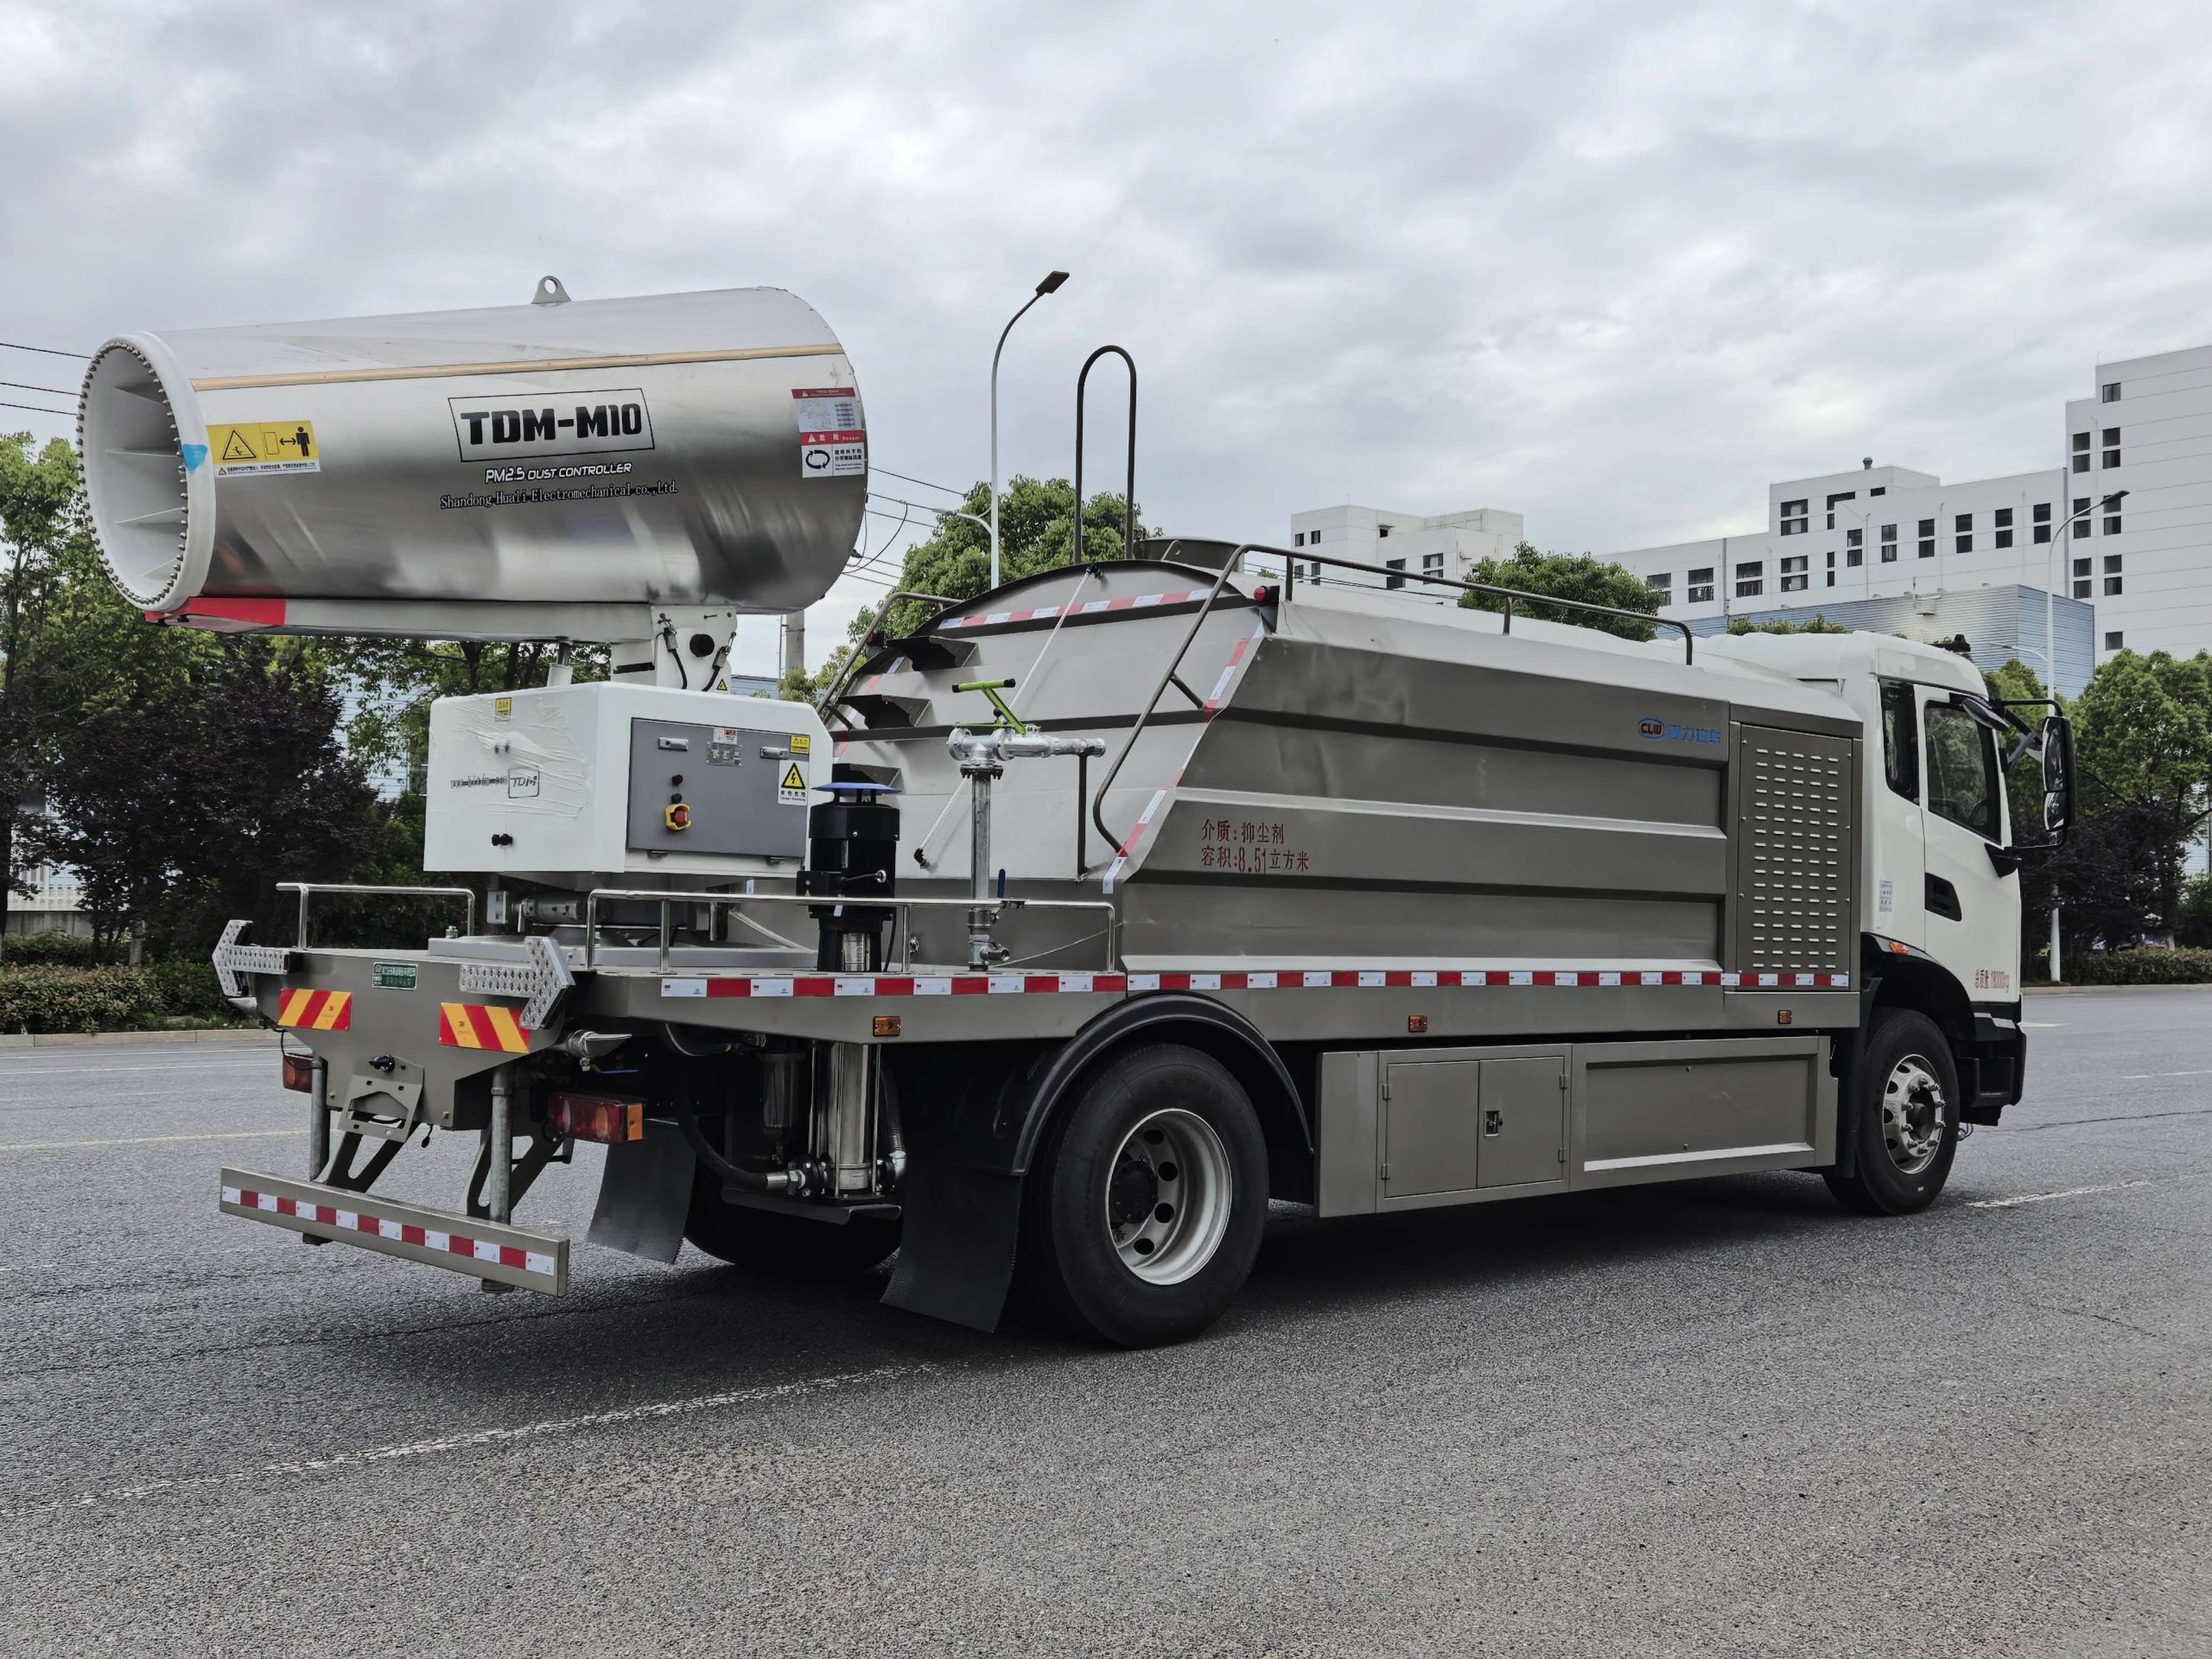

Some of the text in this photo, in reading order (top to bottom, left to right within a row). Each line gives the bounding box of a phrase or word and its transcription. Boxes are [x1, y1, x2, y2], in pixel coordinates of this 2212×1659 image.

[461, 403, 642, 445] TDM-M10
[485, 462, 632, 484] PM2.5 DUST CONTROLLER
[441, 494, 492, 509] Shandong
[495, 489, 527, 505] Huali
[531, 482, 631, 503] Electromechanical
[510, 775, 537, 787] TDM
